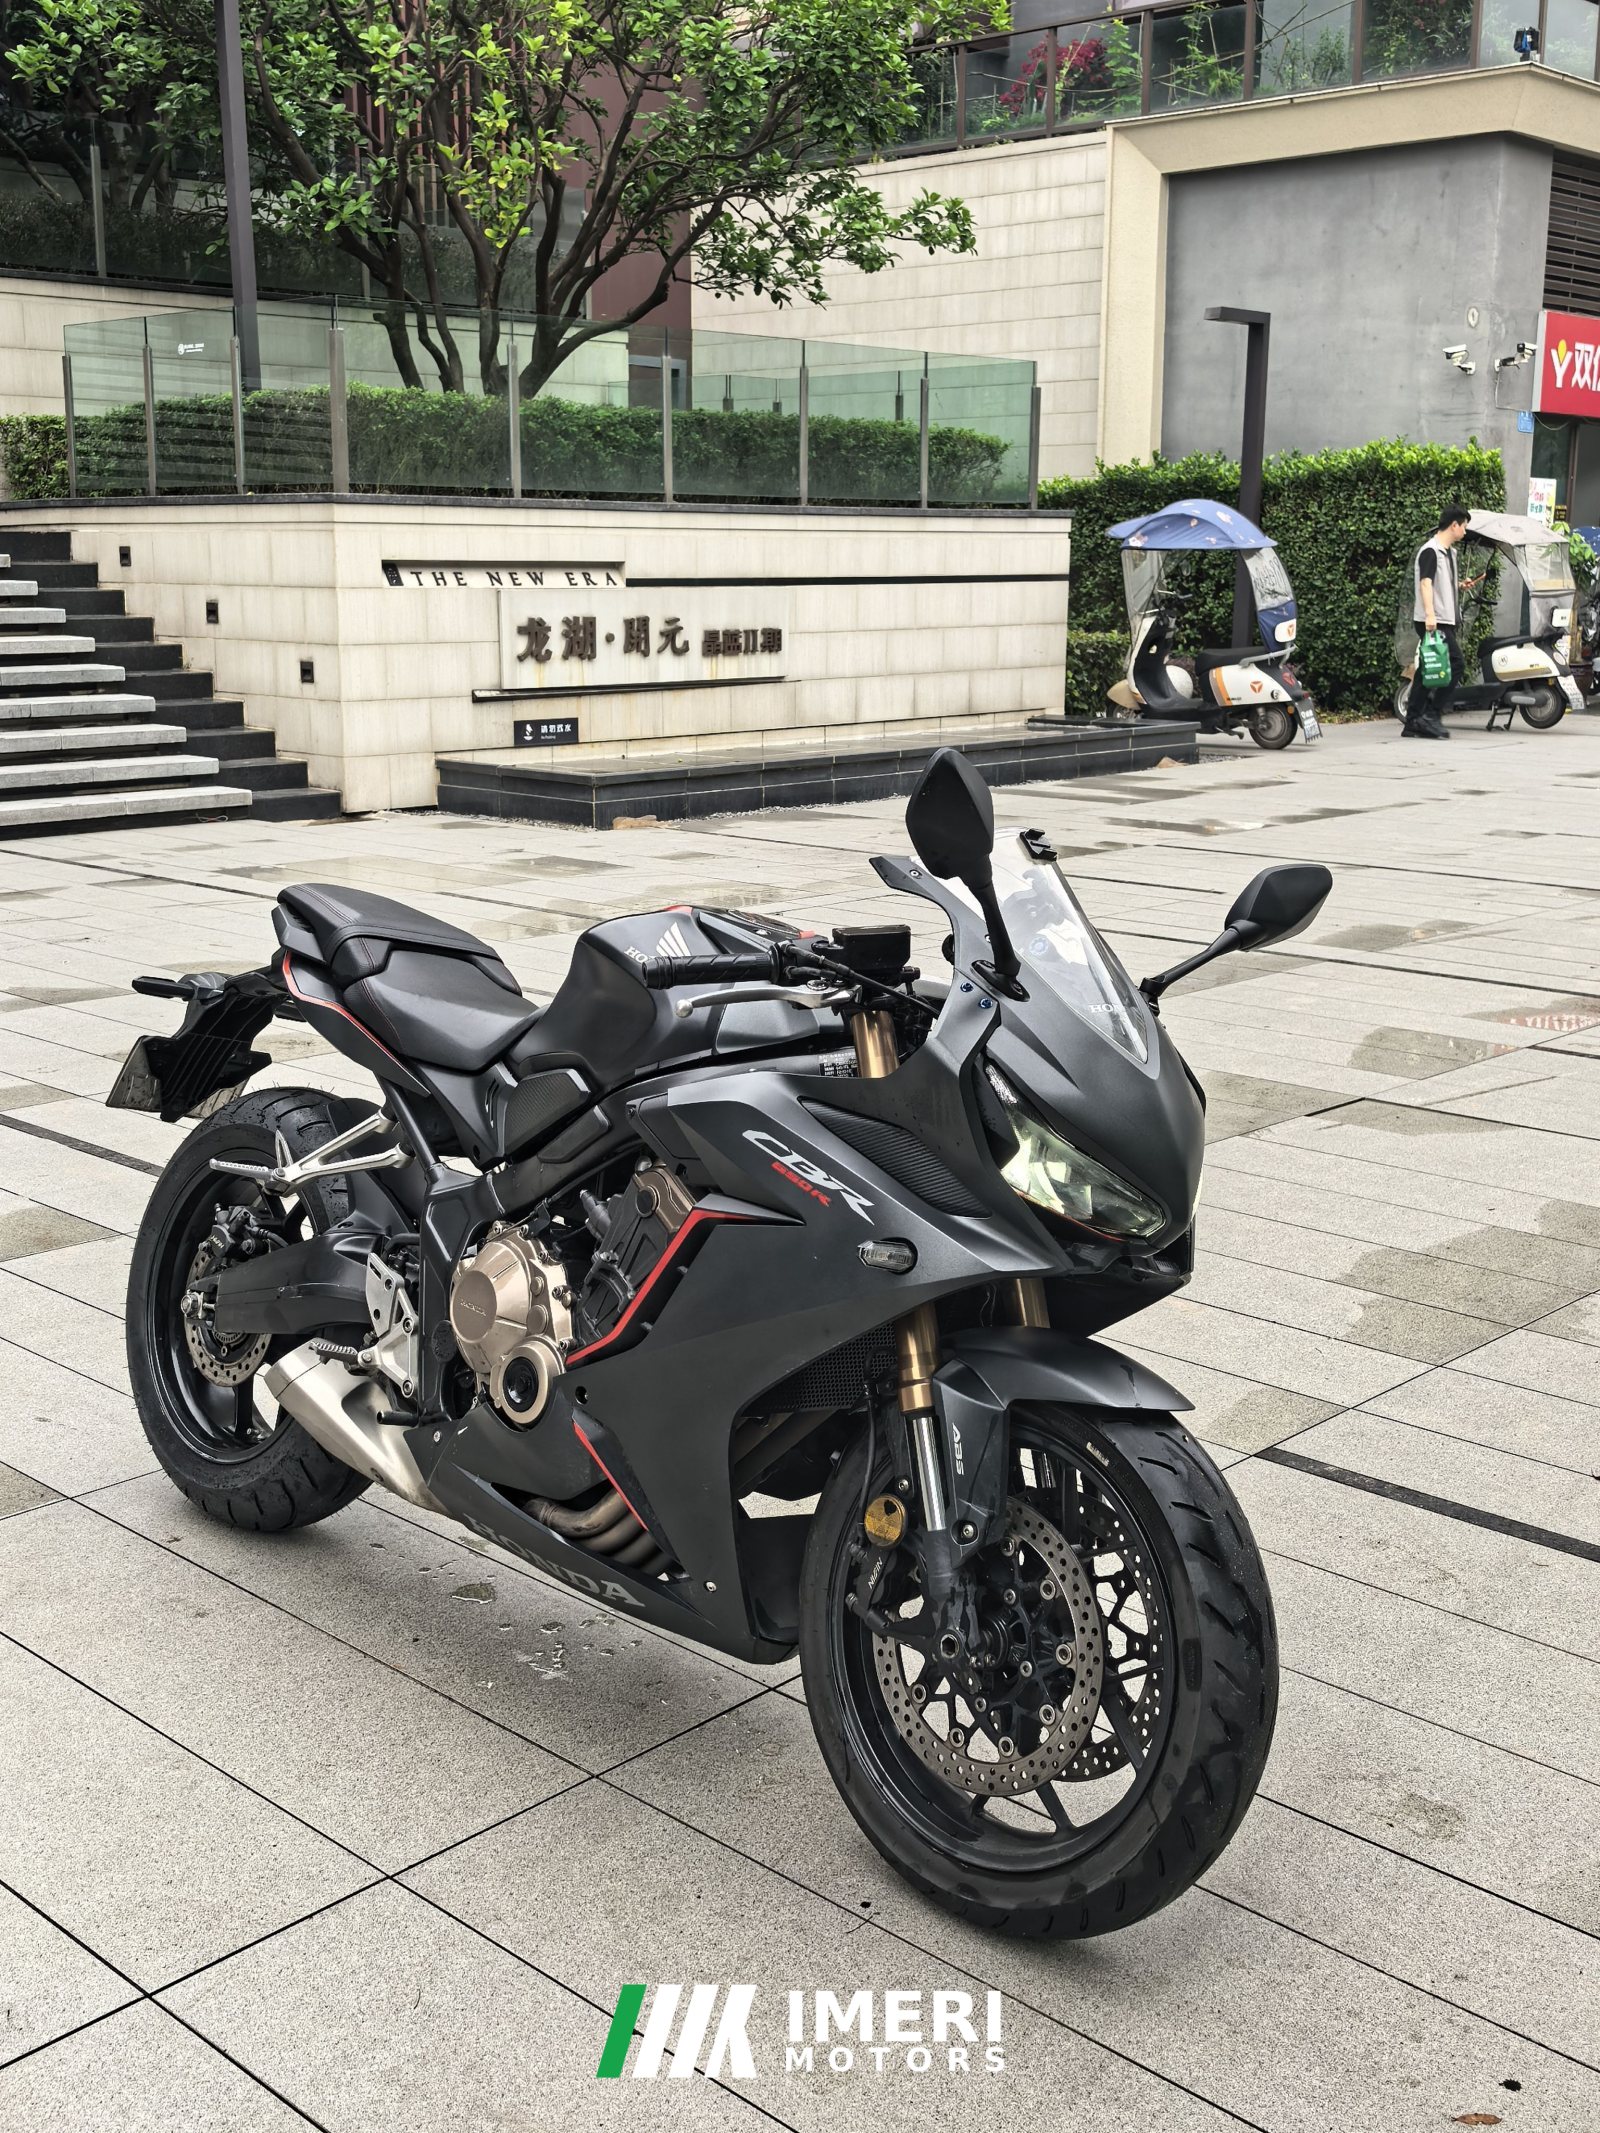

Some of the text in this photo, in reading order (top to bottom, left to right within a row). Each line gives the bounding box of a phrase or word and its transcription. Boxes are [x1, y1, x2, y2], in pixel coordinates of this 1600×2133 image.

[410, 571, 468, 586] THE
[486, 571, 544, 586] NEW
[565, 571, 617, 587] ERA
[742, 1129, 875, 1226] CBR
[952, 1421, 965, 1476] ABS
[463, 1512, 646, 1608] HONDA
